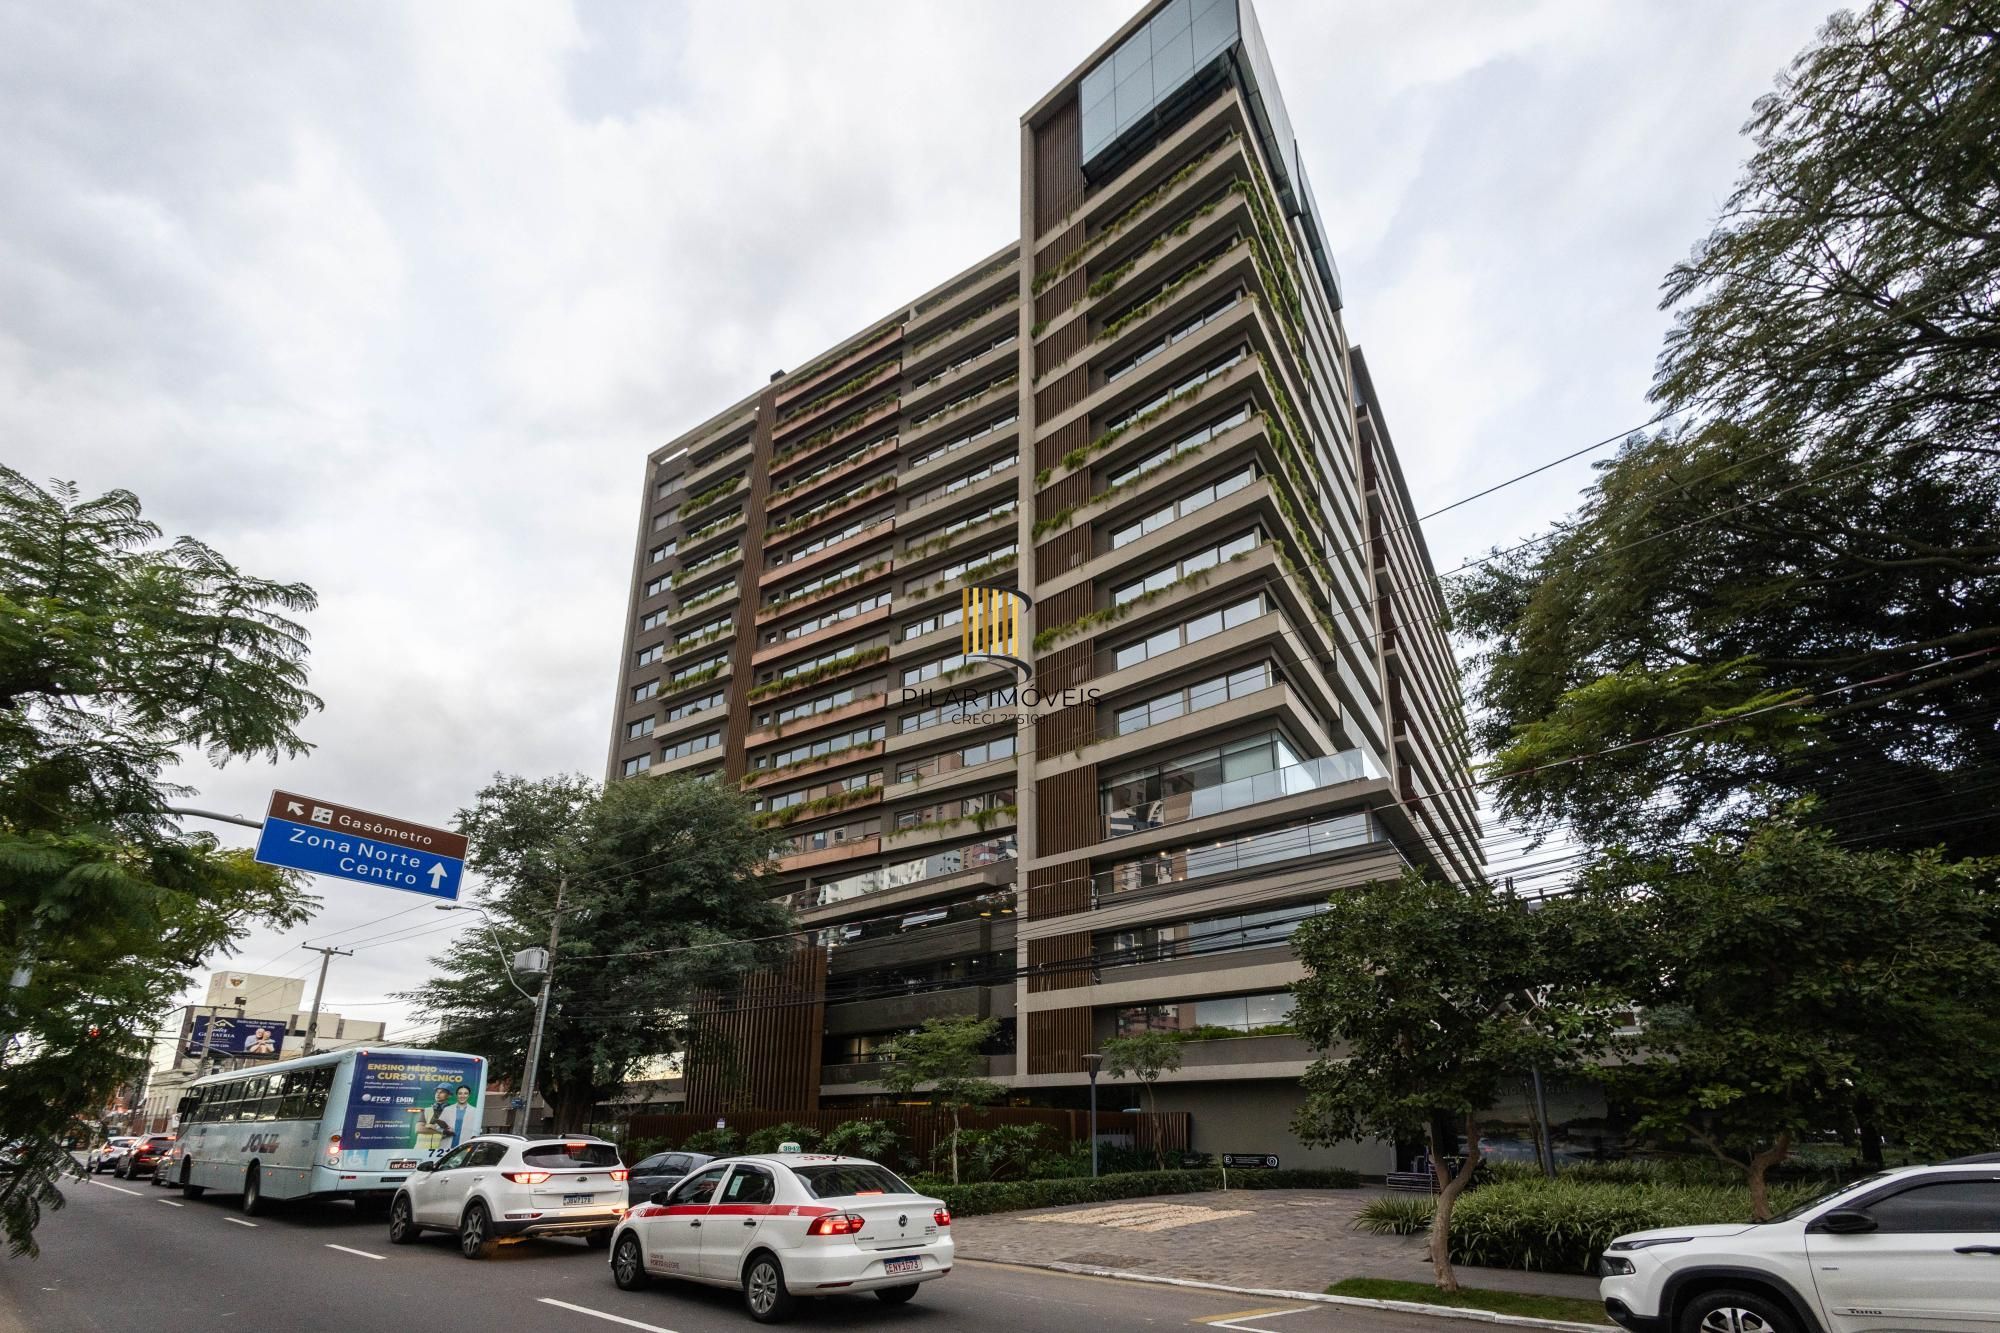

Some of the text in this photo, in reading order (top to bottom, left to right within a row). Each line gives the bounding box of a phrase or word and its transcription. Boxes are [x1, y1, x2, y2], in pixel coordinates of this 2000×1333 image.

[339, 815, 432, 845] Gasômetro
[289, 828, 421, 868] Zona Norte
[340, 858, 417, 885] Centro
[367, 1063, 405, 1071] ENSINO
[407, 1063, 438, 1073] MÉDIO
[377, 1072, 416, 1080] CURSO
[419, 1073, 463, 1082] TÉCNICO
